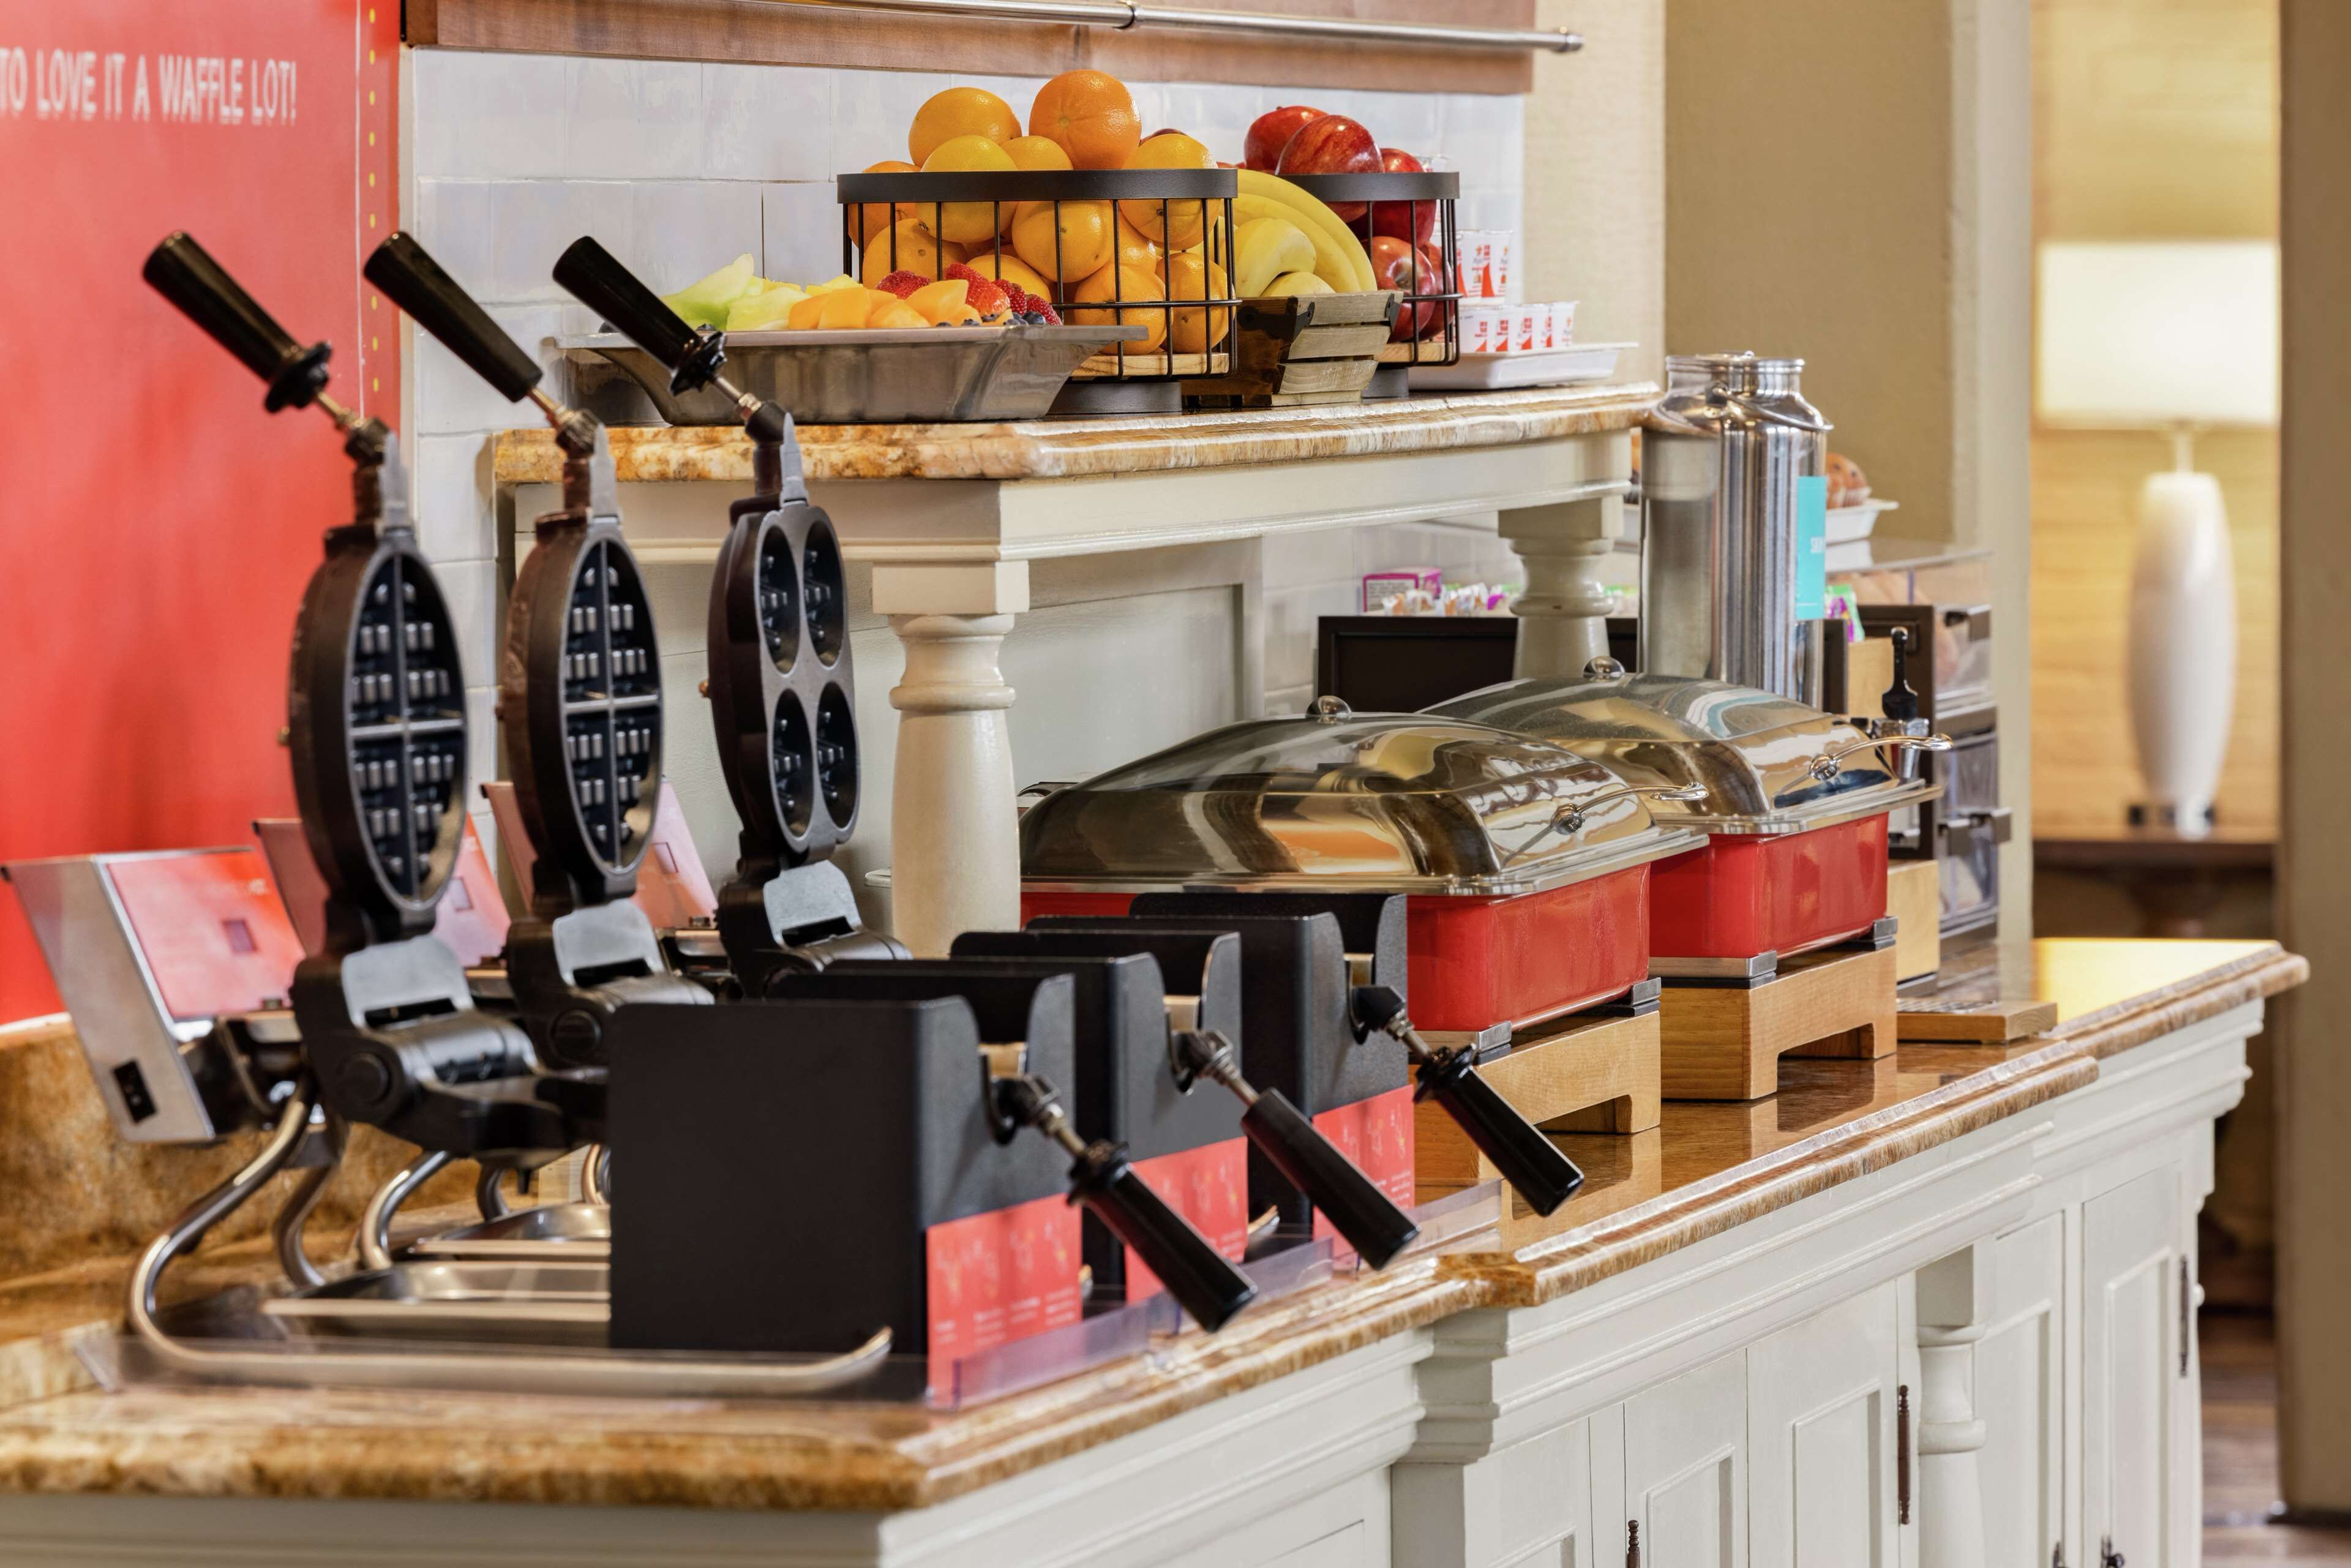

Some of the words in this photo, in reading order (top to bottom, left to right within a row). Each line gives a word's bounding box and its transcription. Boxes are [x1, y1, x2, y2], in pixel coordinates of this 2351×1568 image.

[36, 47, 97, 119] LOVE
[104, 51, 126, 119] IT
[132, 53, 151, 121] A
[159, 54, 244, 124] WAFFLE
[251, 58, 297, 125] LOT!
